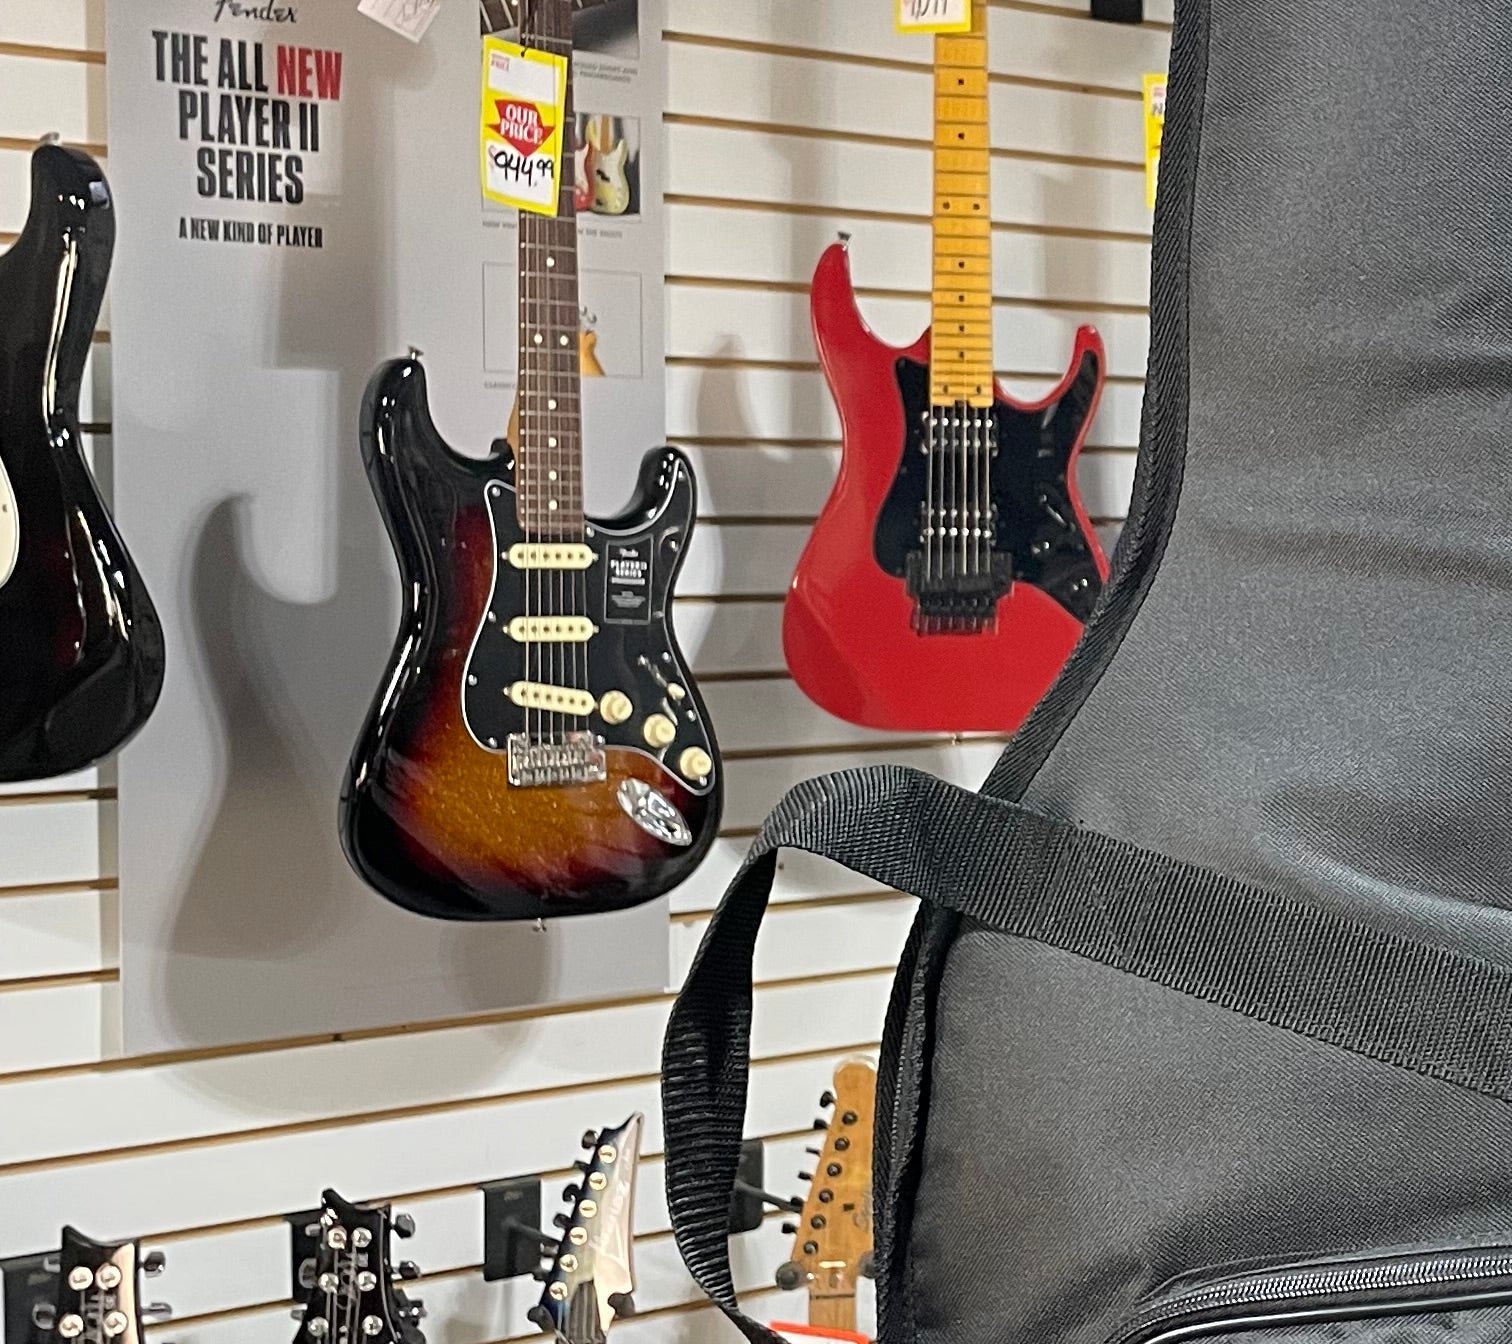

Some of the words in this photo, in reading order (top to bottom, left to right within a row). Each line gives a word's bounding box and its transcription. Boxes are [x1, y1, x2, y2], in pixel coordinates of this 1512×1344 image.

[152, 30, 209, 87] THE
[217, 38, 268, 93] ALL
[276, 44, 343, 101] NEW
[178, 89, 291, 151] PLAYER
[299, 102, 321, 153] II
[500, 119, 544, 144] PRICE
[505, 103, 539, 127] OUR
[196, 147, 305, 205] SERIES
[178, 216, 188, 239] A
[190, 217, 221, 242] NEW
[222, 220, 256, 244] KIND
[257, 223, 274, 245] OF
[275, 224, 323, 249] PLAYER
